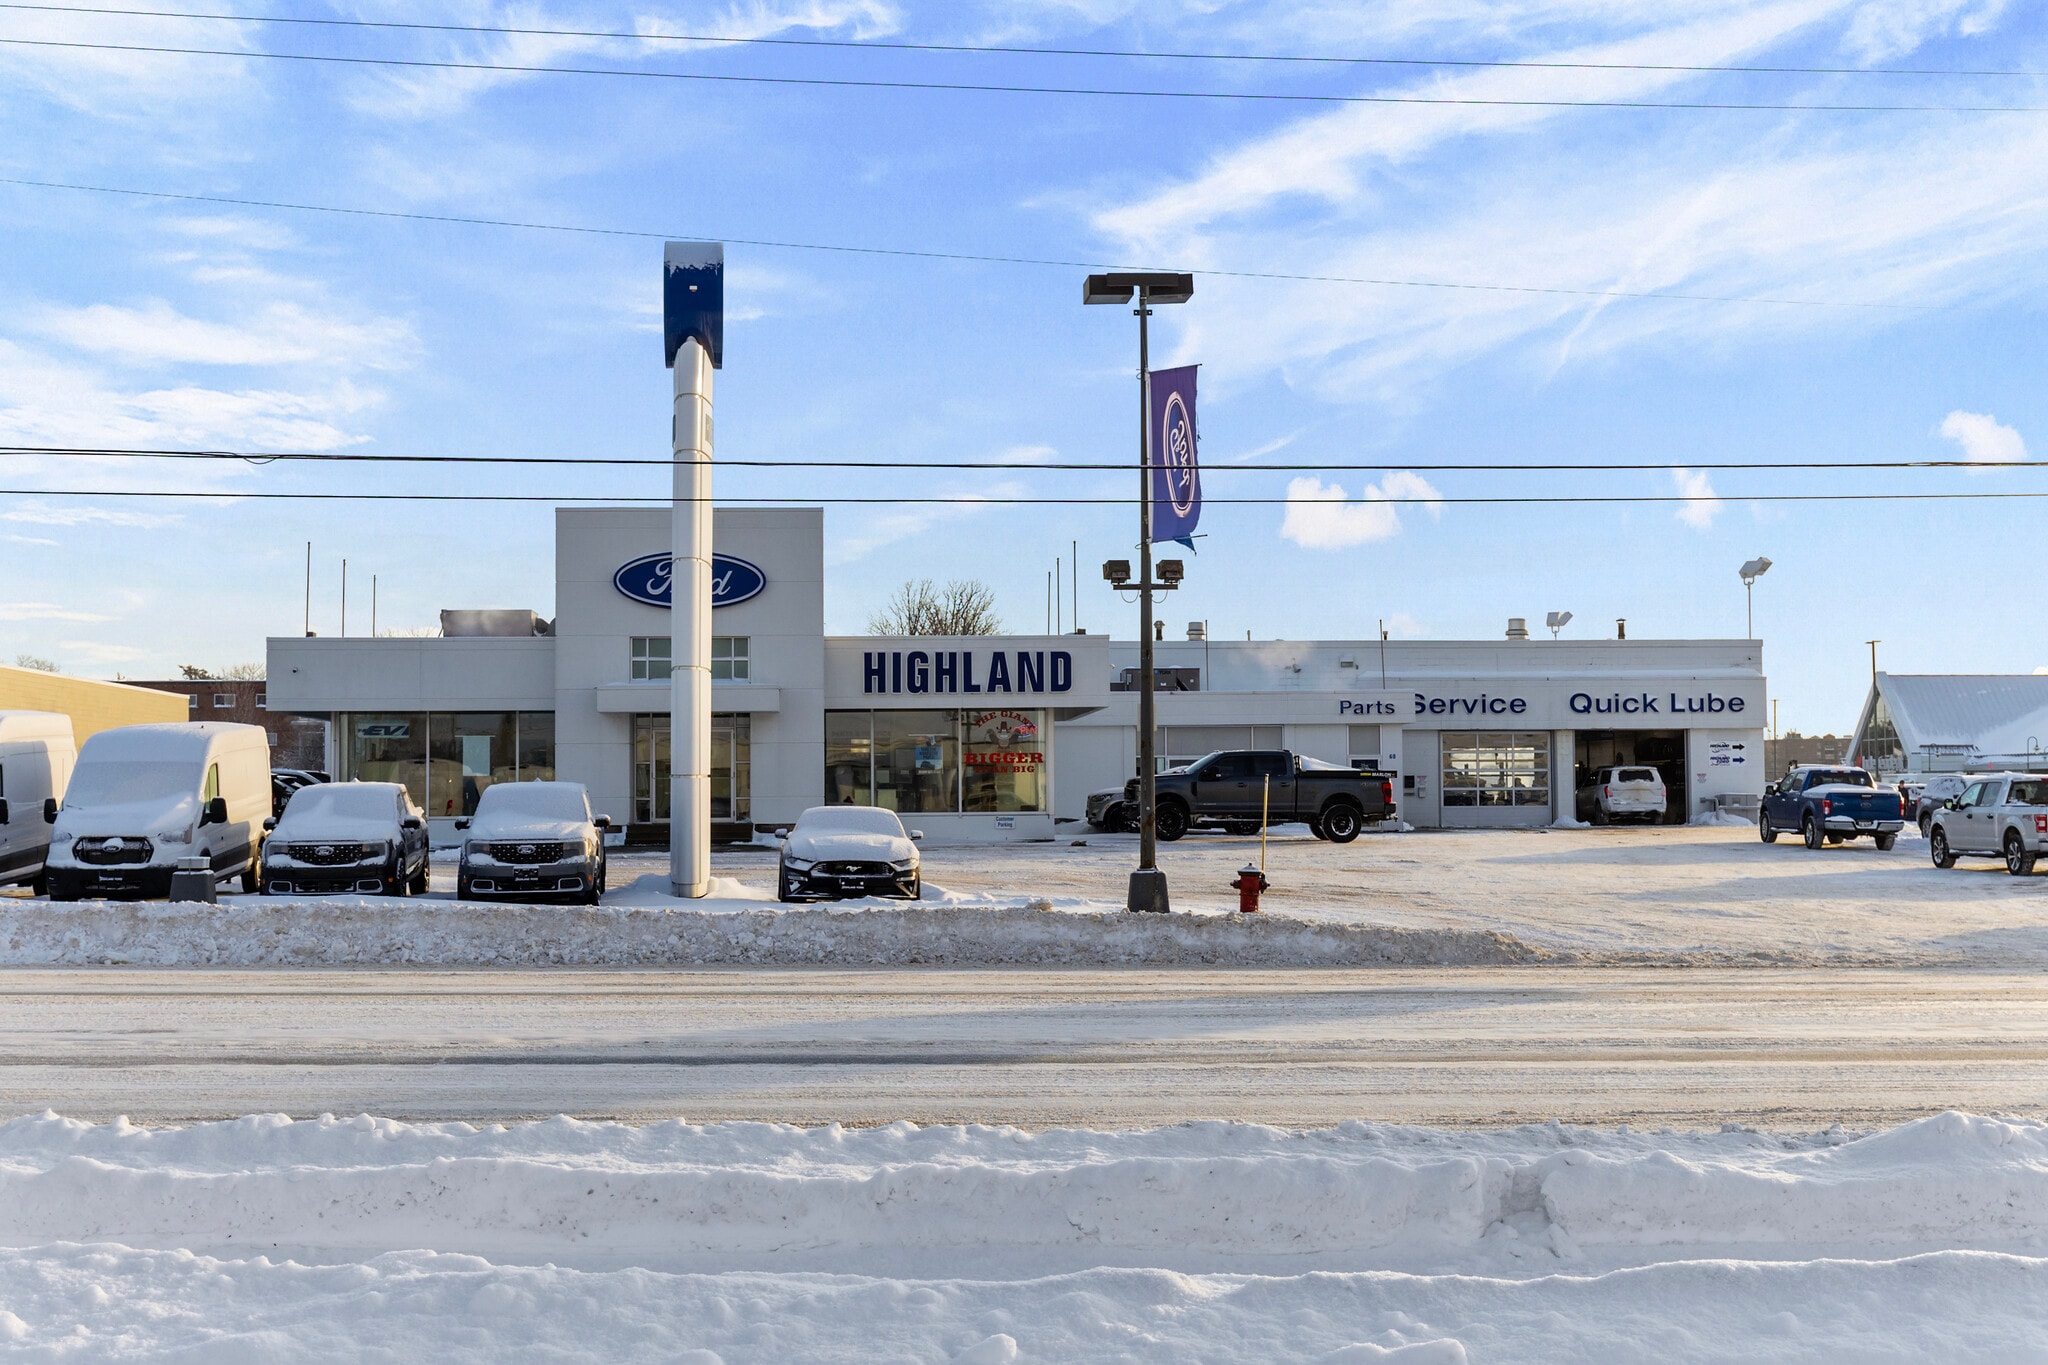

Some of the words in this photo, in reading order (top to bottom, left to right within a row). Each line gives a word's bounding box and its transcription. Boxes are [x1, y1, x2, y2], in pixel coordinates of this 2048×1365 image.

[646, 560, 733, 596] Fd
[863, 650, 1073, 694] HIGHLAND
[1338, 699, 1396, 715] Parts
[1415, 693, 1528, 715] Service
[1568, 692, 1660, 714] Quick
[1670, 692, 1746, 714] Lube
[975, 711, 997, 728] THE
[962, 752, 1044, 765] BIGGER
[975, 765, 1009, 774] THAN
[1012, 765, 1036, 773] BIG
